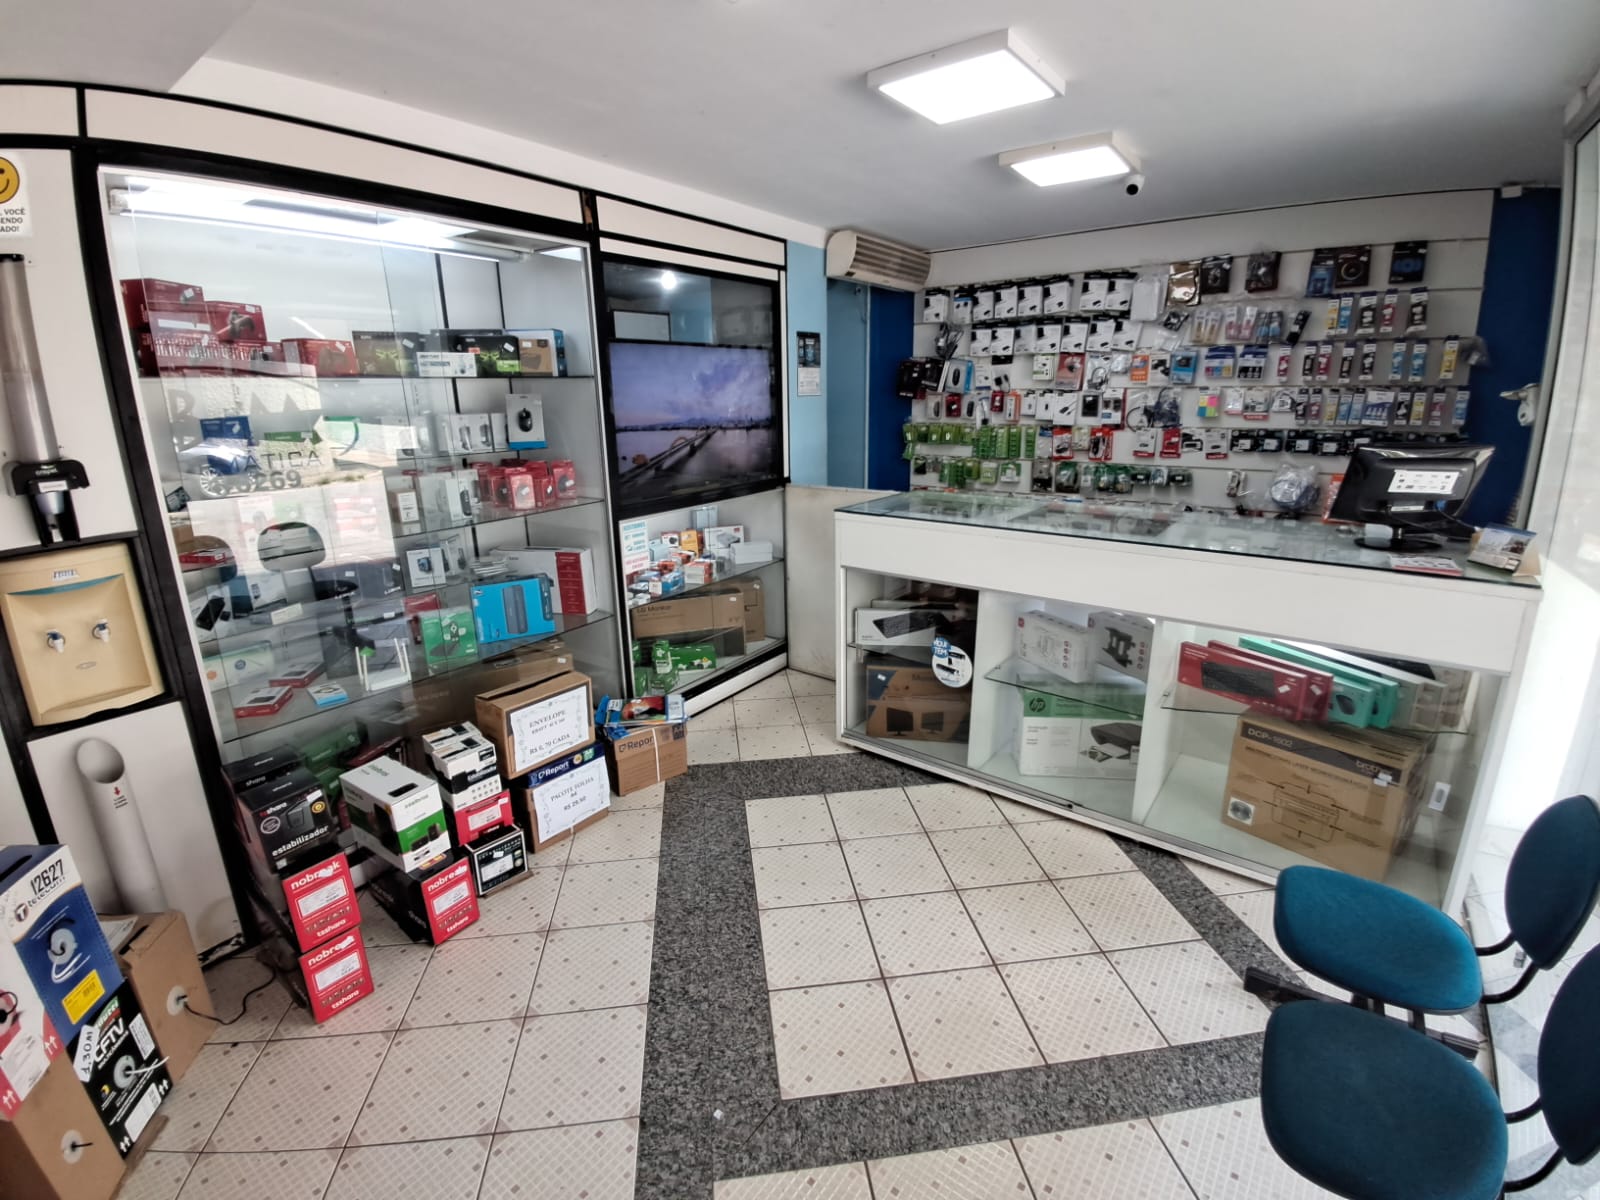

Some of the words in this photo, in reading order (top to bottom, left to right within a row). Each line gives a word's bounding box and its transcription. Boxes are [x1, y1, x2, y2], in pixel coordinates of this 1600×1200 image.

[530, 710, 565, 728] ENVELOPE
[553, 733, 570, 745] CADA
[627, 735, 656, 750] Repor
[545, 761, 569, 776] Report
[272, 825, 329, 856] estabilizador
[30, 858, 64, 896] 12627
[94, 1017, 124, 1062] CFTV
